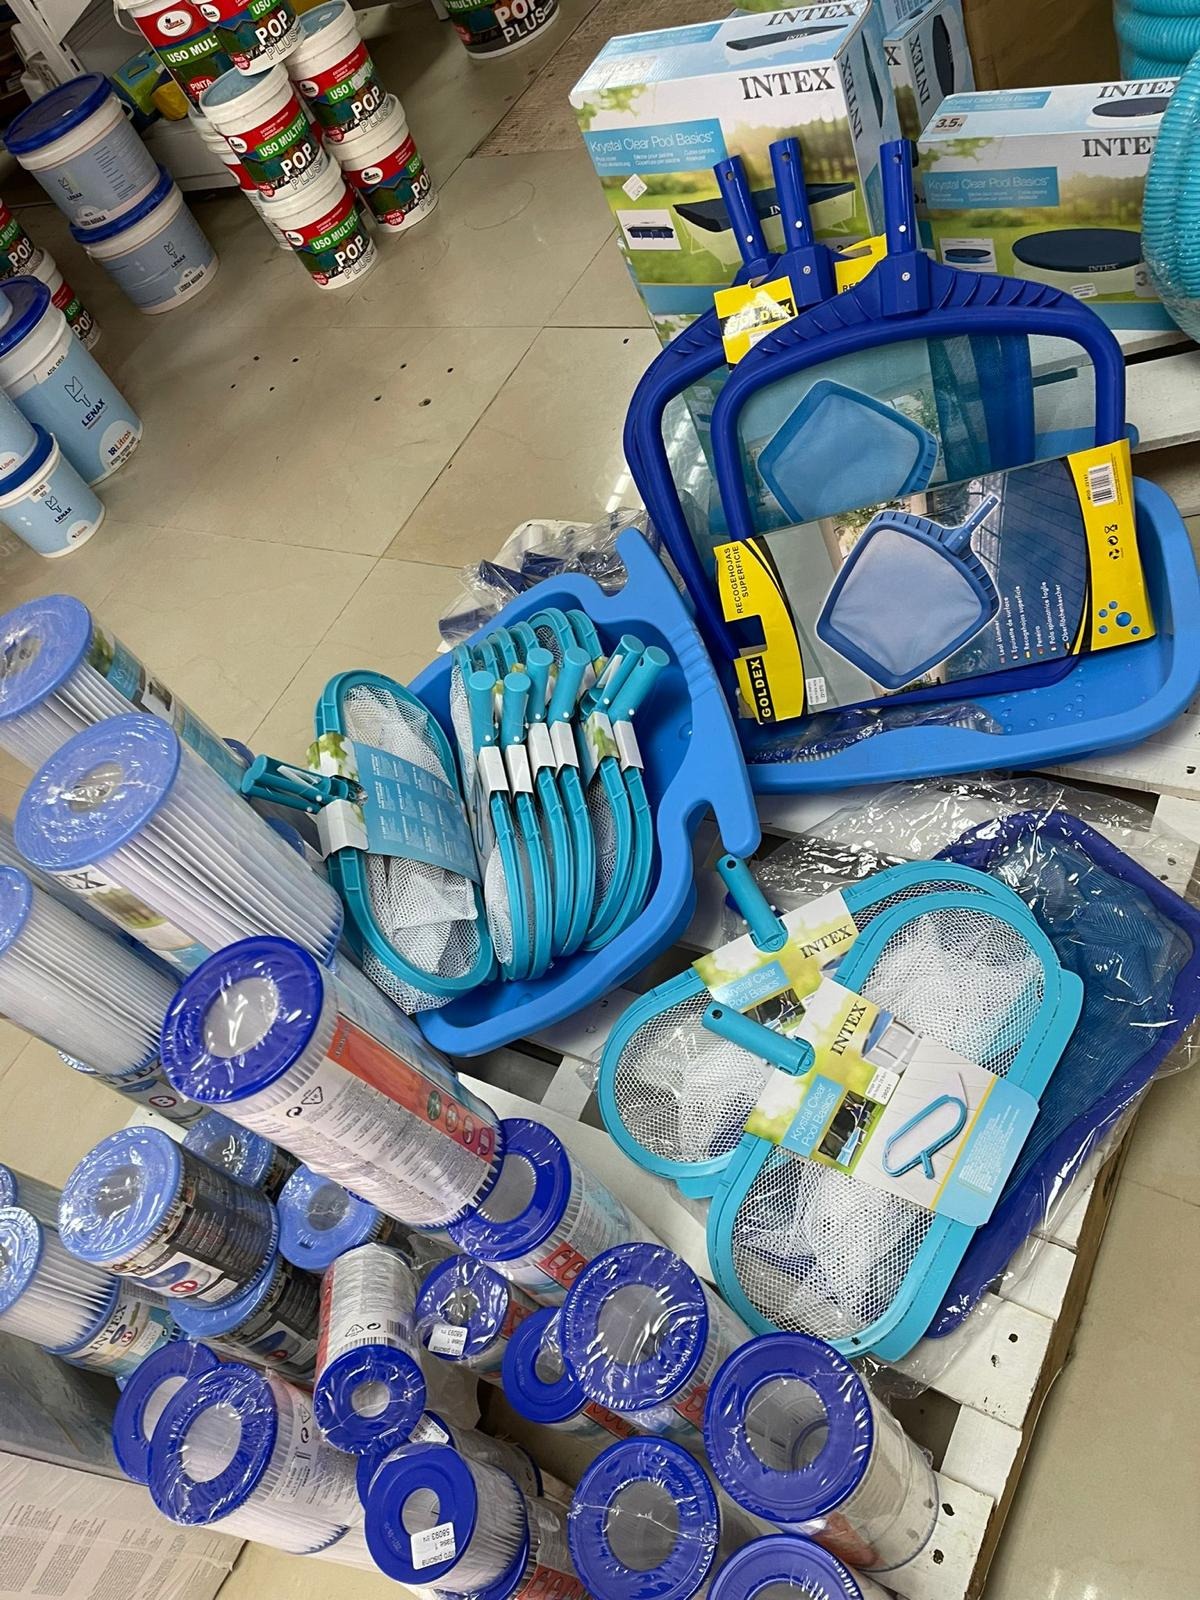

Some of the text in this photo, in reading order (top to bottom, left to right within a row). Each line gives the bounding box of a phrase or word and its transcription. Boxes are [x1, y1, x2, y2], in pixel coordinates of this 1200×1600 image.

[255, 10, 289, 46] POP
[502, 8, 546, 42] PLUS
[766, 4, 858, 26] INTEX
[166, 35, 218, 64] USO MUL
[265, 29, 299, 60] PLUS
[909, 34, 931, 104] INTEX
[189, 78, 214, 92] PINTA
[330, 84, 350, 100] USO
[738, 67, 836, 101] INTEX
[840, 52, 864, 141] INTEX
[350, 85, 380, 119] POP
[259, 142, 279, 157] USO
[590, 140, 622, 154] Krystal
[623, 138, 650, 150] Clear
[650, 134, 673, 148] Pool
[1082, 136, 1157, 157] INTE
[279, 143, 312, 177] POP
[290, 160, 323, 190] PLUS
[961, 178, 986, 189] Clear
[989, 177, 1010, 188] Pool
[8, 238, 32, 267] POP
[312, 237, 332, 250] USO
[334, 235, 364, 267] POP
[72, 310, 92, 338] POP
[81, 398, 106, 427] LENAX
[115, 430, 132, 449] Litros
[54, 507, 73, 523] LENAX
[724, 547, 744, 615] RECOGEHOJAS
[732, 545, 750, 598] SUPERFICIE
[750, 659, 772, 718] GOLDEX
[800, 925, 853, 959] INTEX
[752, 968, 776, 984] Clear
[728, 992, 750, 1010] Pool
[830, 1001, 868, 1056] INTEX
[790, 1083, 826, 1141] Krystal Clear
[801, 1124, 820, 1147] Pool
[90, 1304, 128, 1350] INTEX
